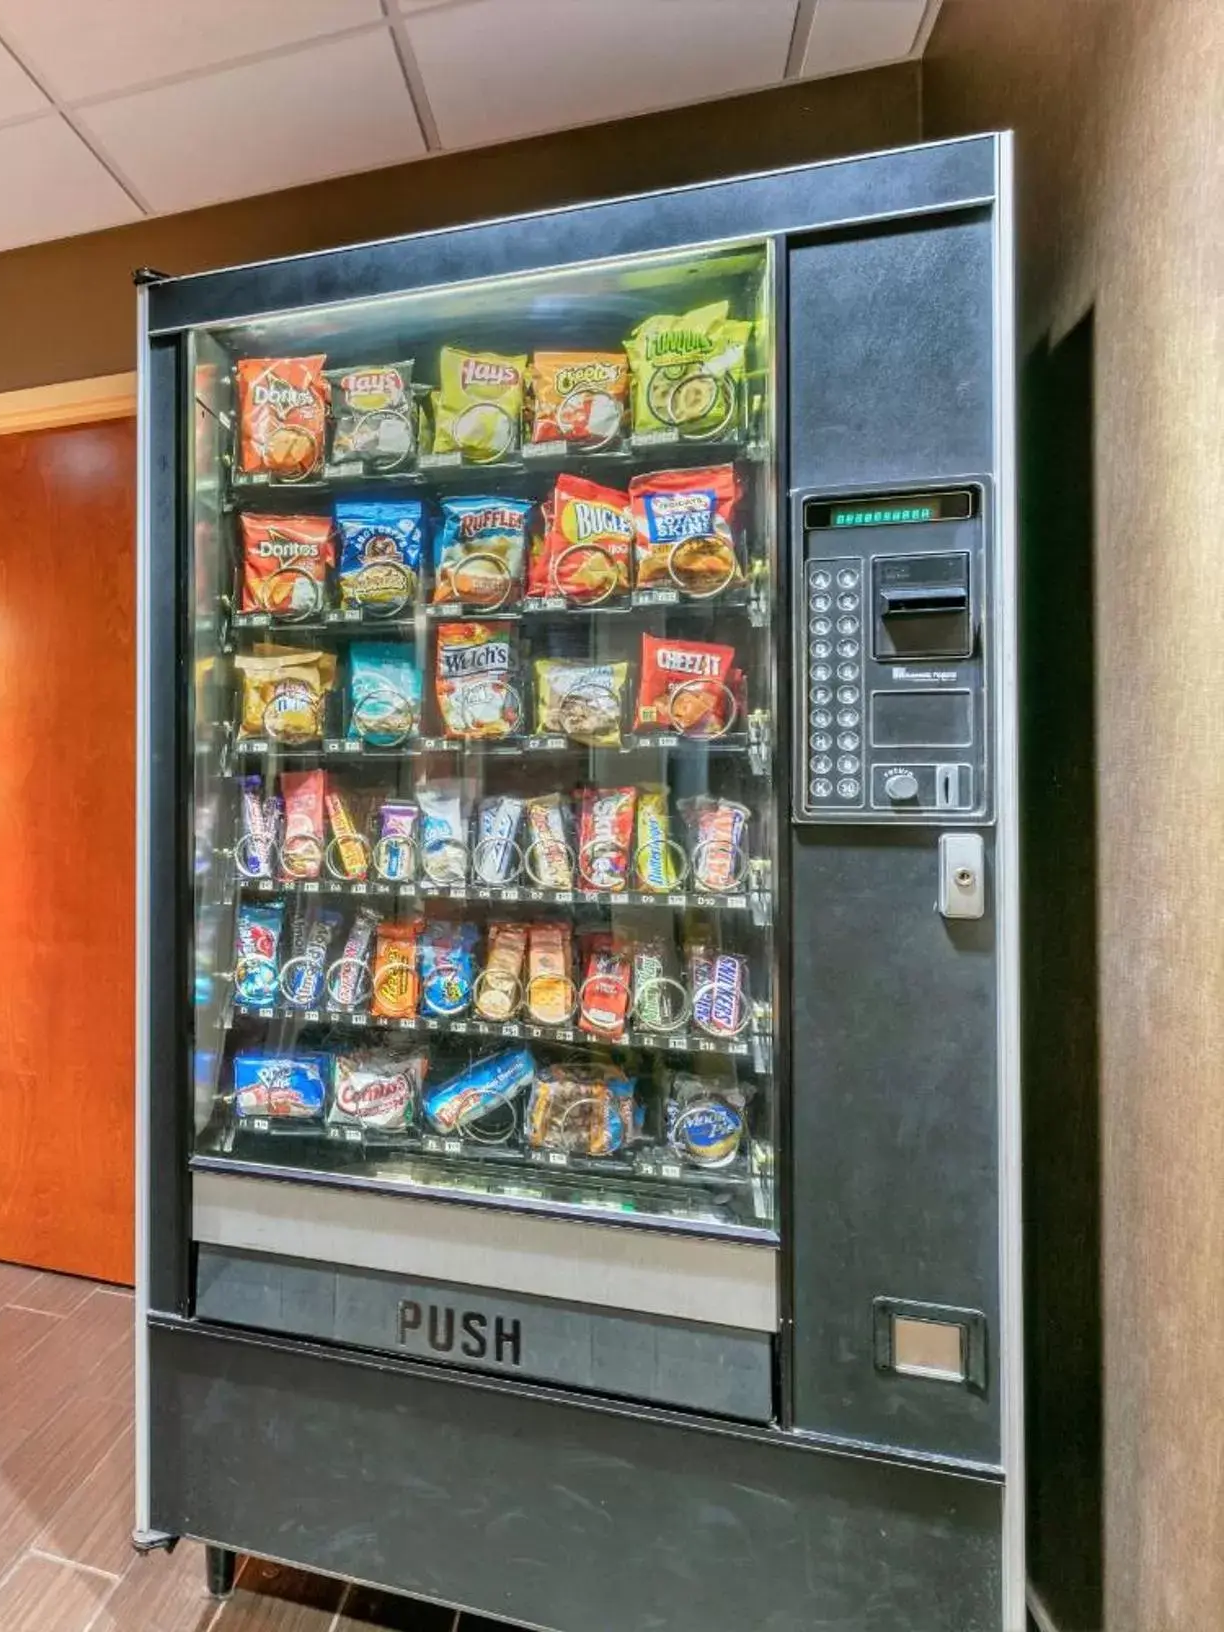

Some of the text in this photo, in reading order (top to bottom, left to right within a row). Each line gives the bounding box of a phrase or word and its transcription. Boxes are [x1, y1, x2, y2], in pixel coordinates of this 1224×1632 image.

[254, 386, 314, 405] Doritos
[260, 541, 319, 559] Doritos
[445, 645, 508, 673] Welch's
[883, 767, 914, 778] return
[592, 796, 619, 884] Skittles
[647, 815, 665, 886] Butterfinger
[715, 956, 738, 1027] SNICKERS
[397, 1299, 522, 1366] PUSH
